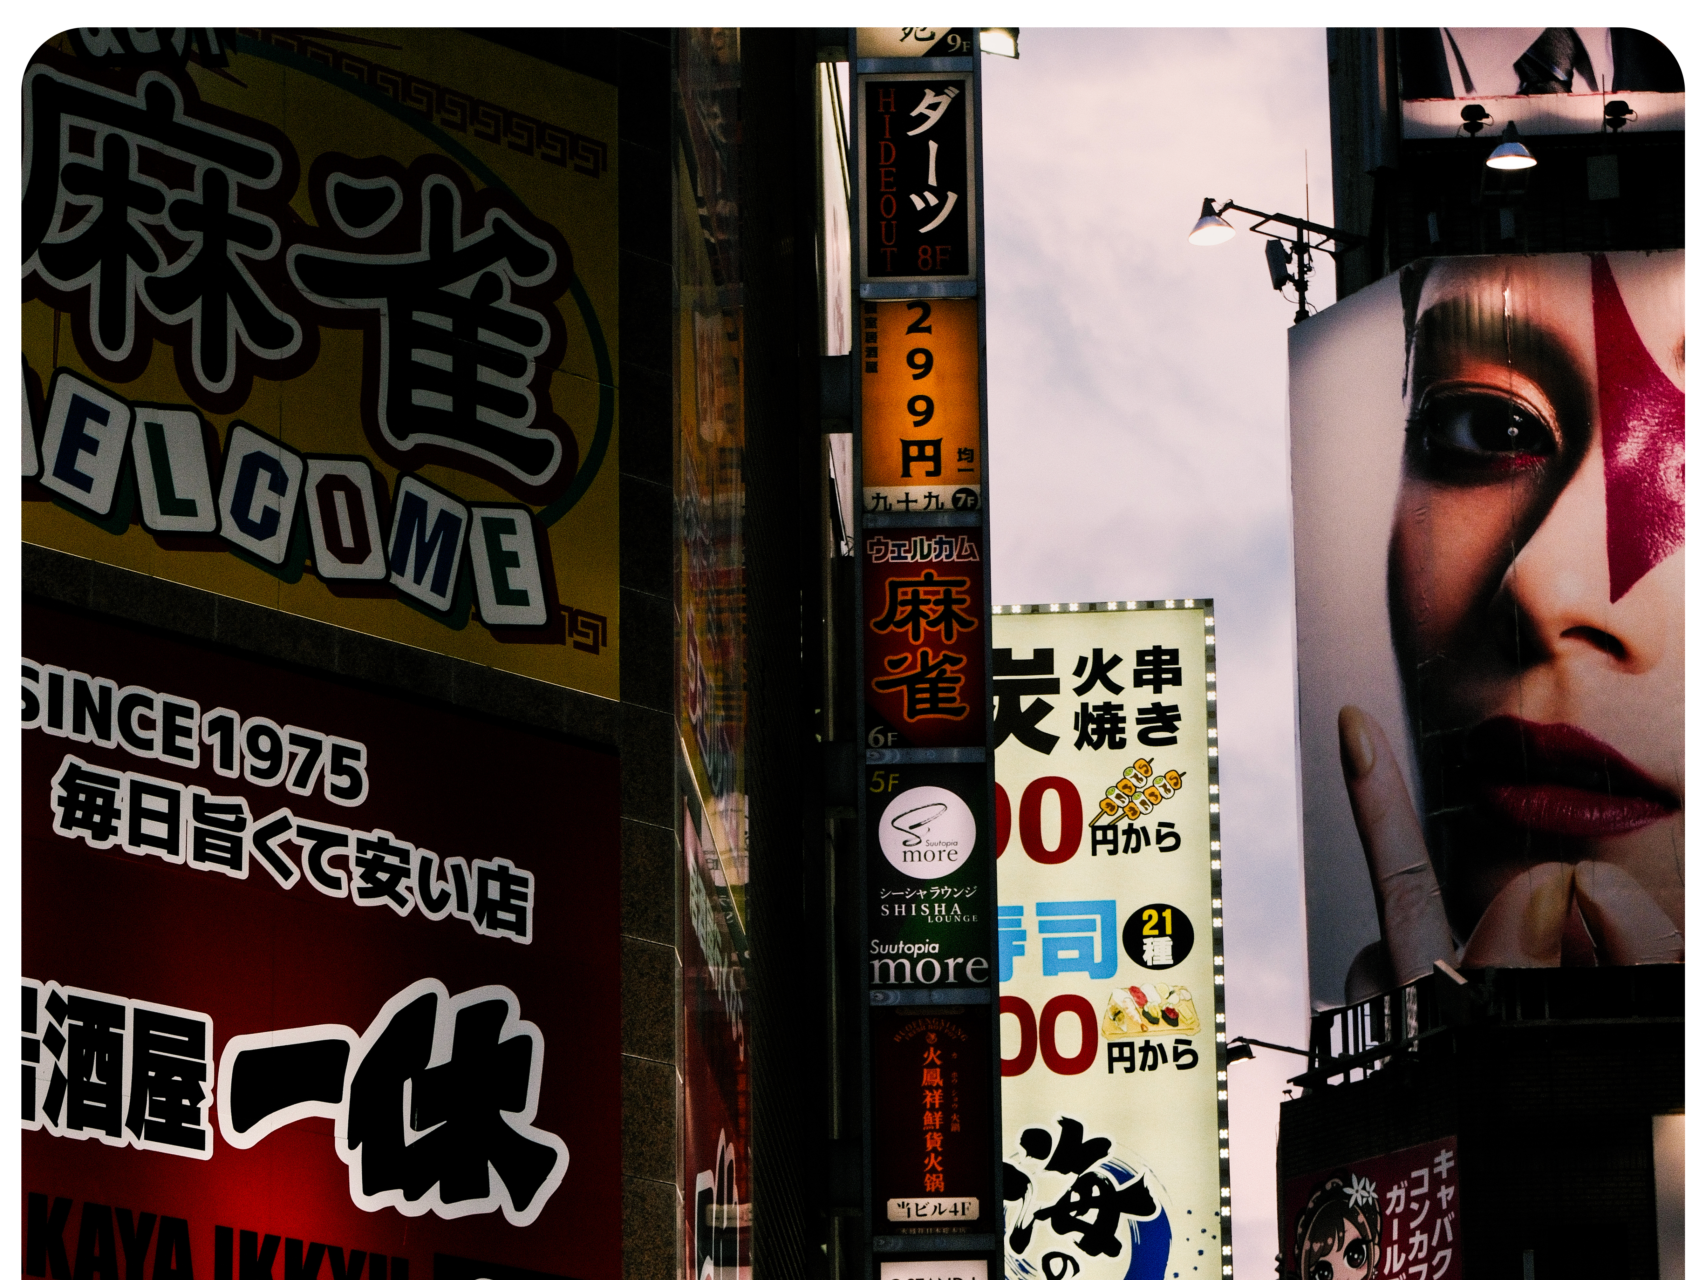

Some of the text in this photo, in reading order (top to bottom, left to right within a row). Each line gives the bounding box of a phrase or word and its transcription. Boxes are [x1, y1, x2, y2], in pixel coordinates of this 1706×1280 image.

[946, 33, 971, 53] 9F
[905, 85, 960, 234] ダーツ
[878, 88, 898, 272] HIDEOUT
[917, 245, 952, 271] 8F
[21, 66, 562, 483] 麻雀
[864, 302, 878, 373] 個室居酒屋
[900, 301, 943, 478] 299円
[957, 447, 975, 473] 均一
[53, 393, 530, 608] ELCOME
[872, 492, 944, 512] 九十九
[955, 493, 975, 509] 7F
[867, 535, 980, 563] ウェルカム
[870, 568, 979, 722] 麻雀
[867, 725, 898, 747] 6F
[1073, 701, 1182, 751] 焼き
[206, 713, 365, 802] 1975
[869, 771, 900, 792] 5F
[55, 760, 533, 940] 毎日旨くて安い店
[925, 839, 958, 847] Suutopia
[1091, 821, 1182, 856] 円から
[902, 849, 958, 862] more
[880, 886, 978, 899] シーシャラウンジ
[881, 902, 962, 917] SHISHA
[928, 914, 978, 923] LOUNGE
[1142, 908, 1172, 936] 21
[870, 938, 940, 957] Suutopia
[1142, 936, 1174, 966] 種
[869, 956, 989, 985] more
[1107, 1038, 1199, 1074] 円から
[229, 990, 560, 1214] 一休
